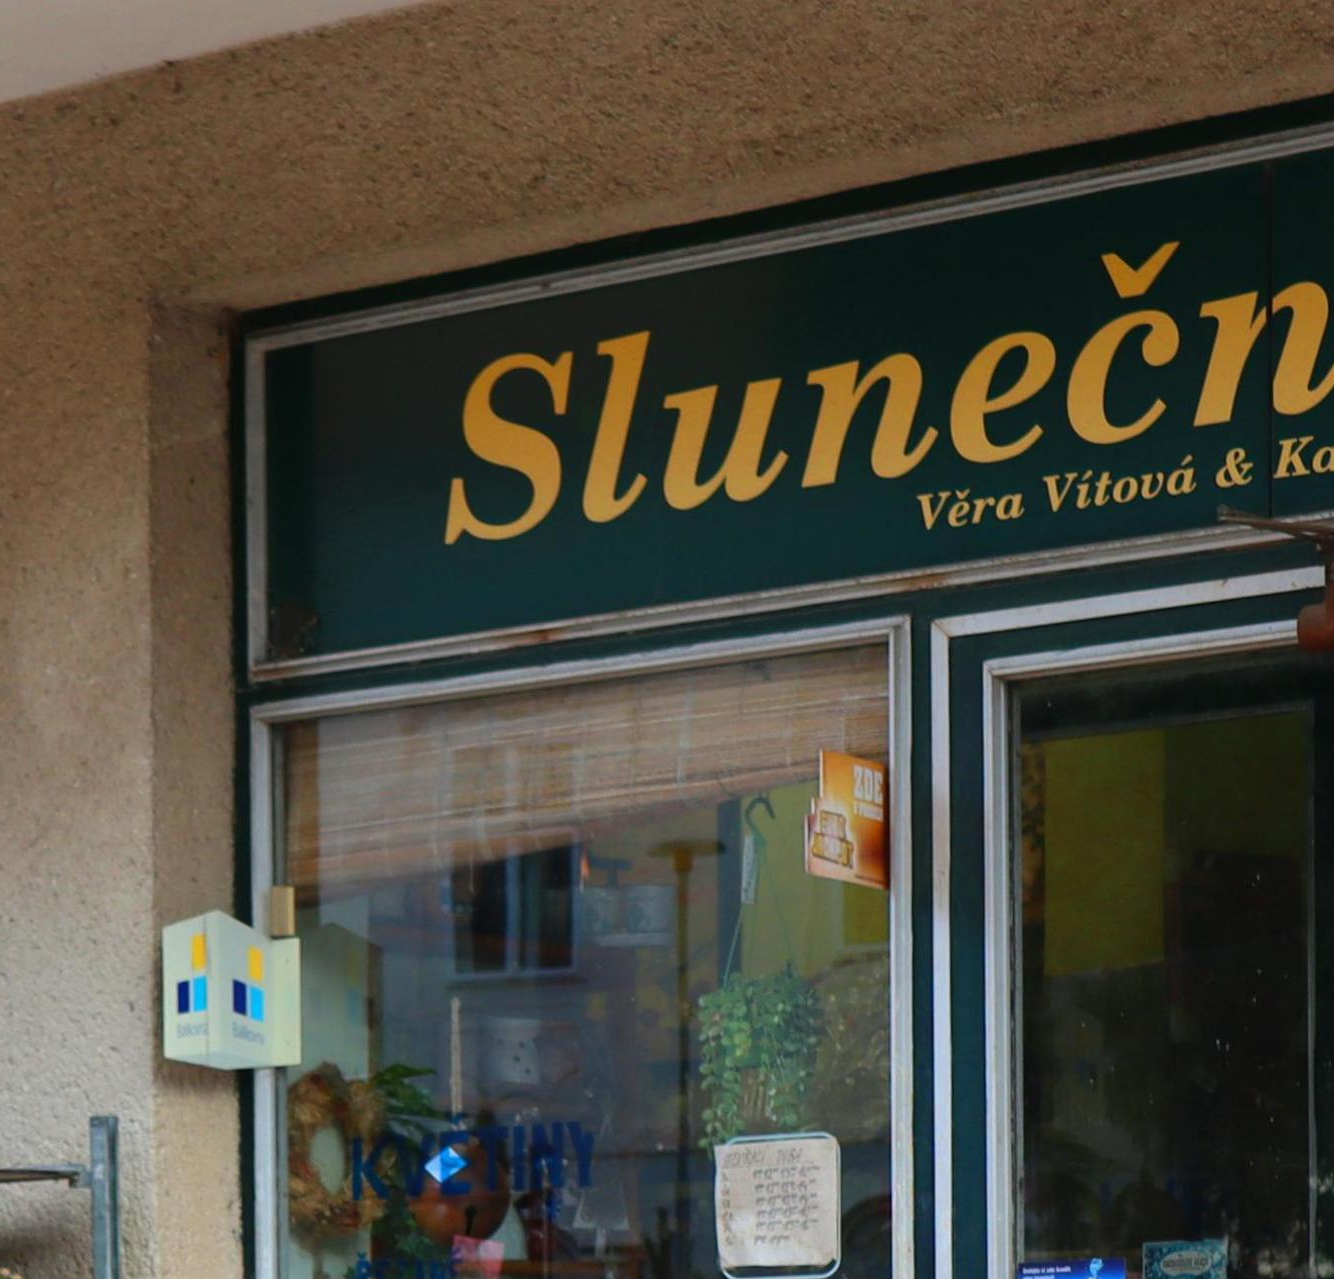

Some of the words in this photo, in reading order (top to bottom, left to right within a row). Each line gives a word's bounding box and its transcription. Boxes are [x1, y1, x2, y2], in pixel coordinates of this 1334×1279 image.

[916, 487, 1024, 531] Věra
[1042, 456, 1197, 510] Vítová
[1215, 447, 1254, 488] &
[351, 1112, 596, 1201] KVĚTINY
